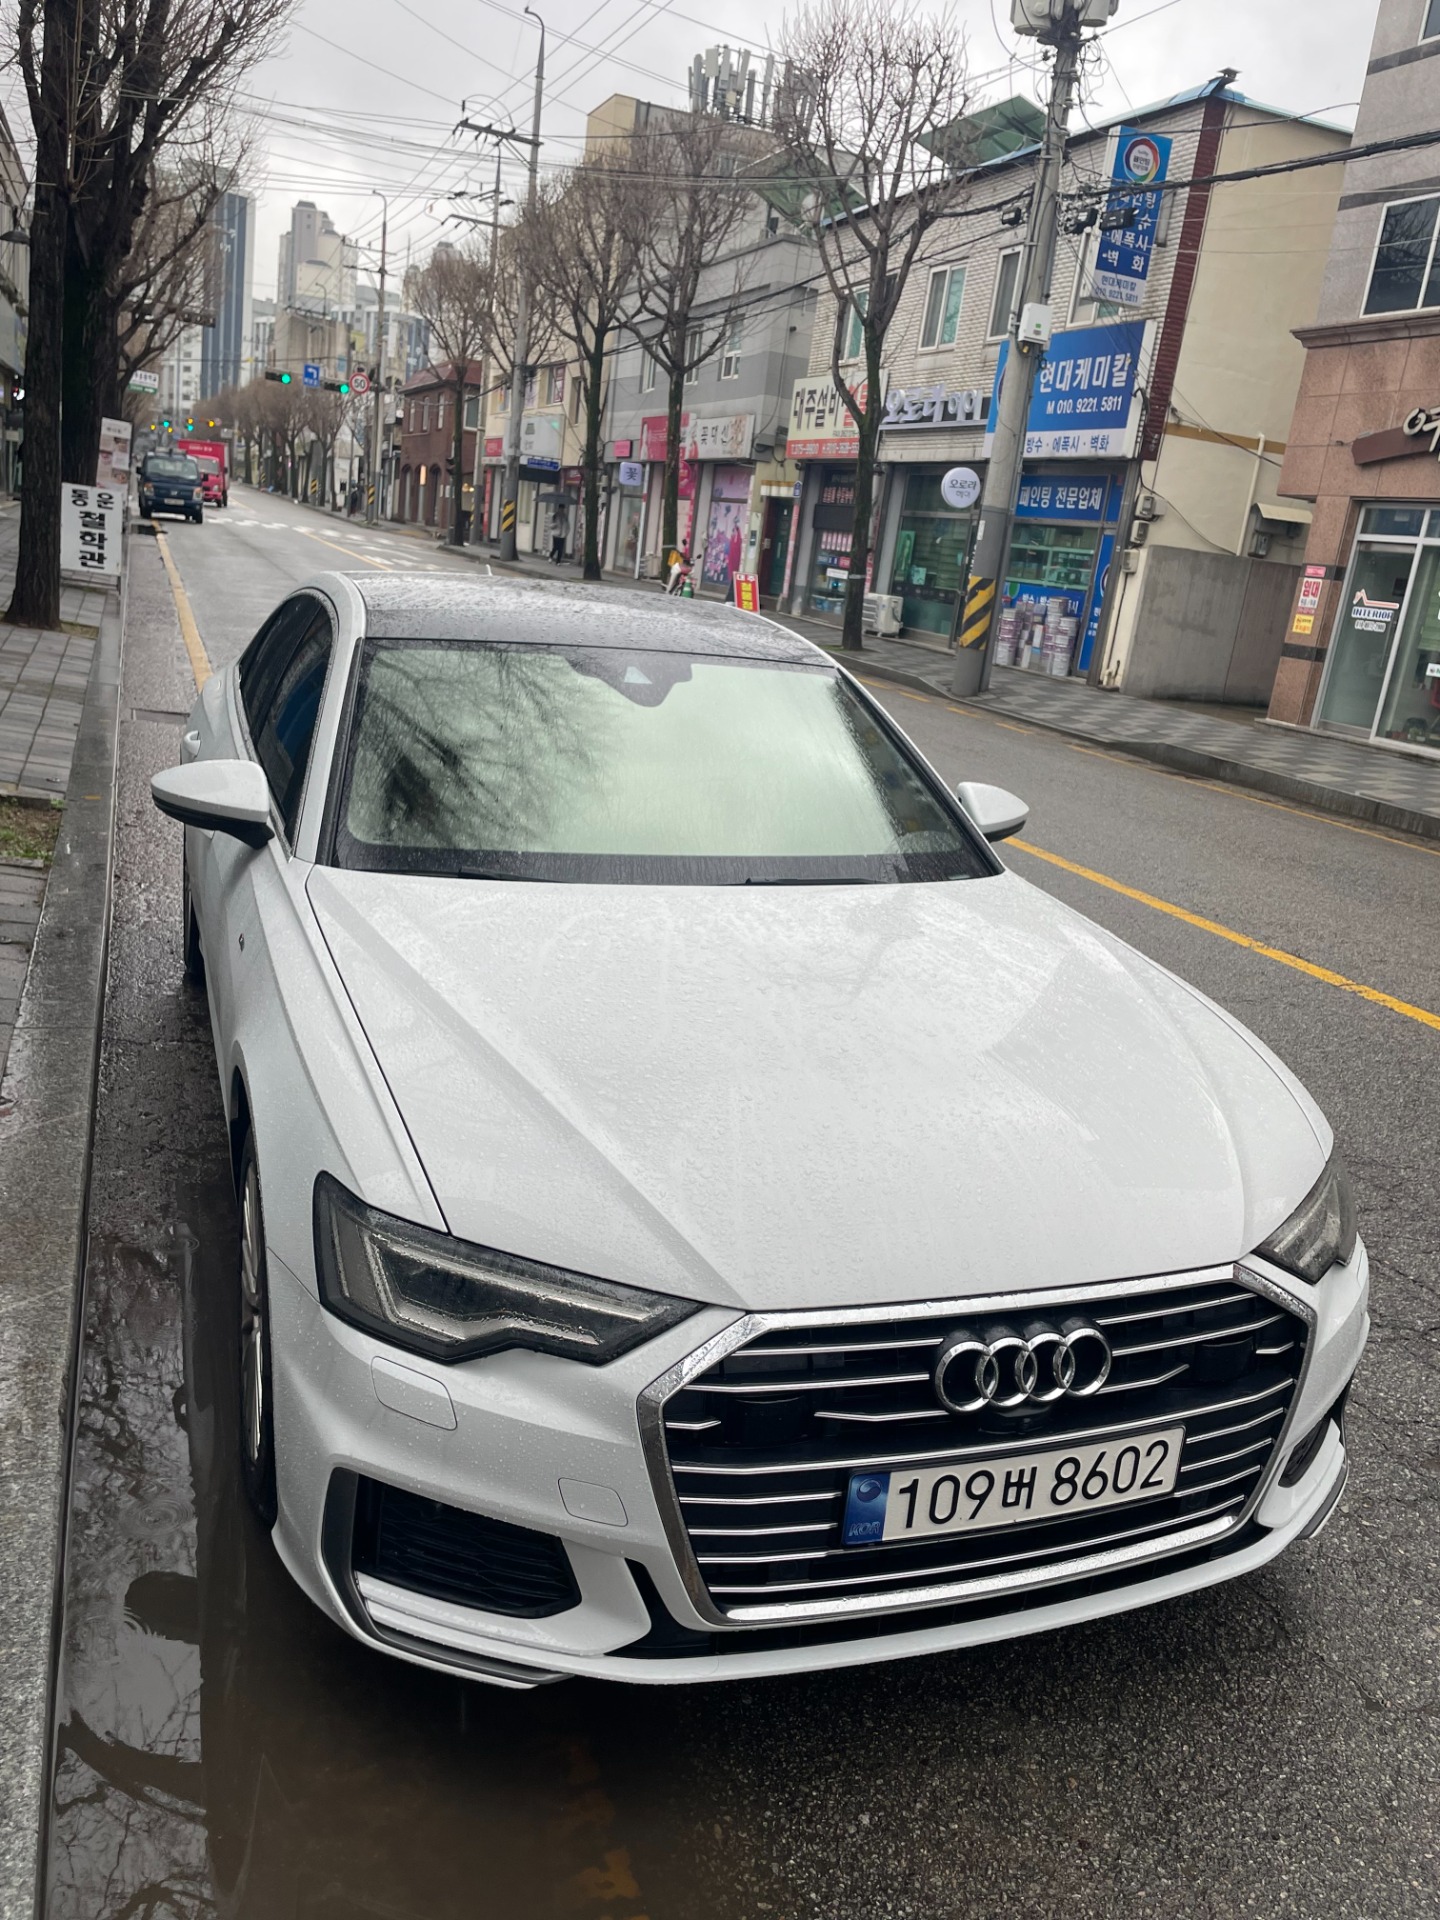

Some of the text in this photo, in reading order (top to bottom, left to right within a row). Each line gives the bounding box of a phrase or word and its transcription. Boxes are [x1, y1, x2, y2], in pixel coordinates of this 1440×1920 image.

[1040, 353, 1132, 393] 현대케미칼
[354, 378, 365, 389] 50
[882, 384, 946, 423] 오로라
[1100, 395, 1123, 411] 5811
[1026, 434, 1110, 454] 방수 에폭시 벽화
[626, 467, 638, 481] 꽃
[949, 479, 977, 491] 오로라
[1018, 486, 1103, 510] 페인팅 전문업체
[1302, 580, 1321, 598] 임대
[1352, 608, 1393, 620] INTERIOR
[1050, 1440, 1169, 1505] 8602
[848, 1521, 881, 1537] KOR
